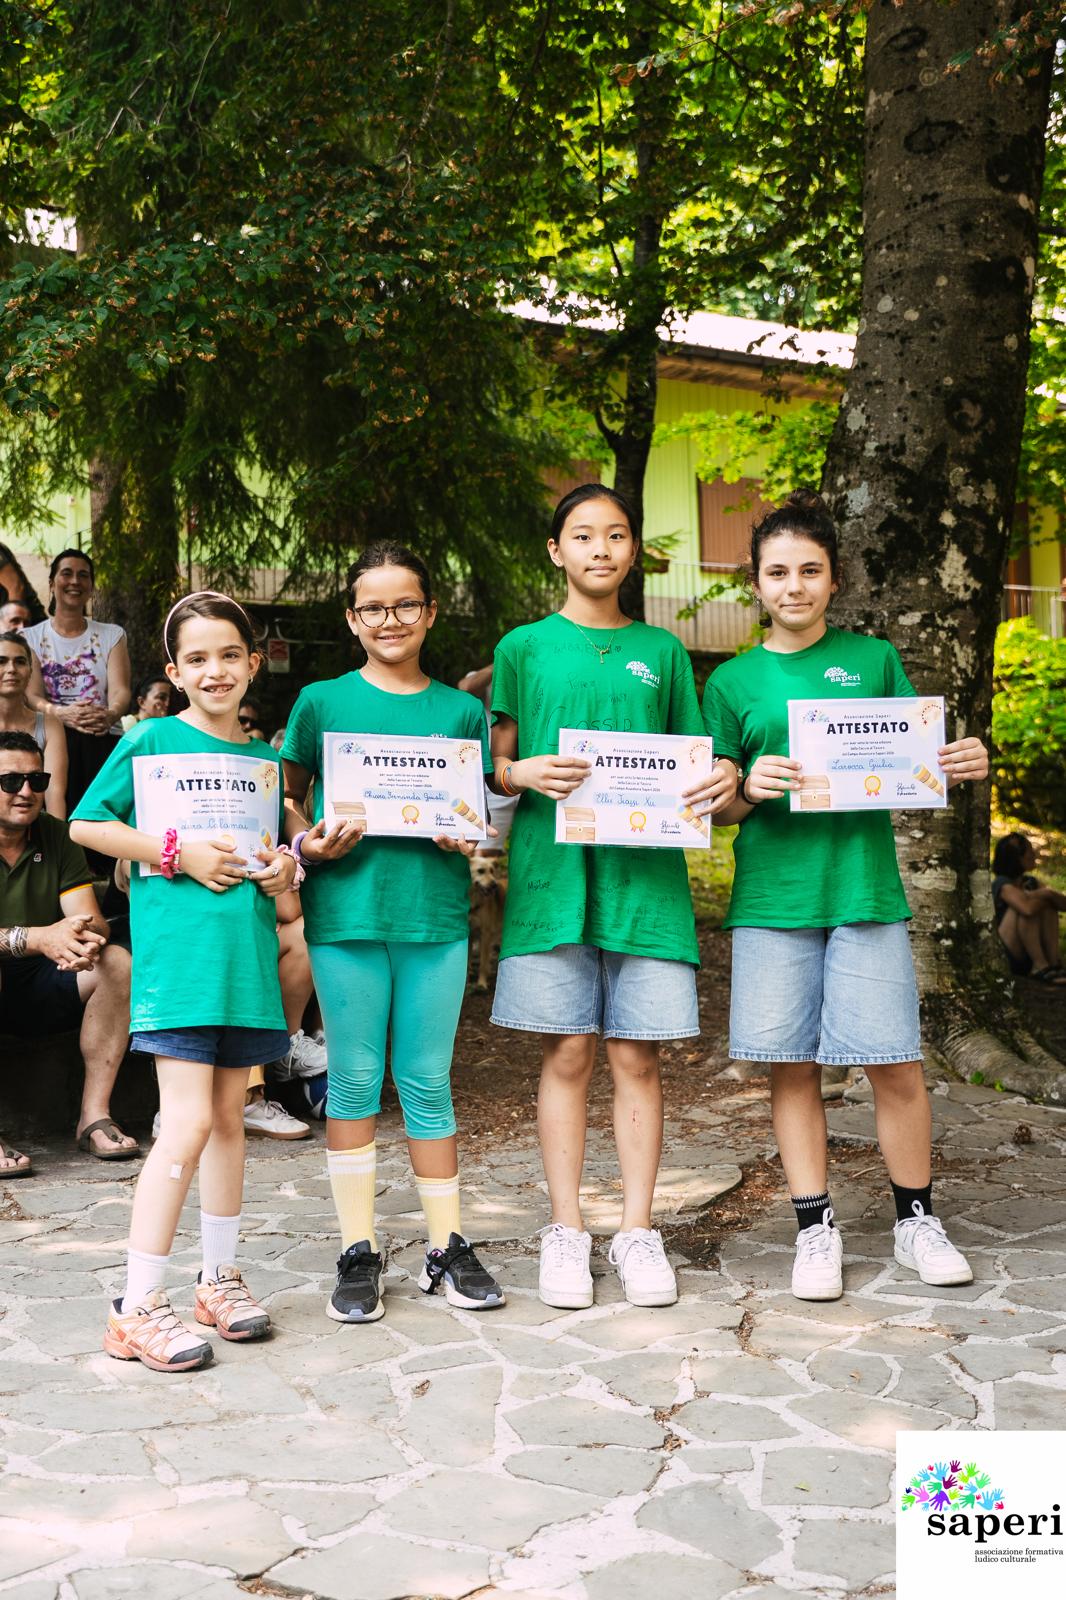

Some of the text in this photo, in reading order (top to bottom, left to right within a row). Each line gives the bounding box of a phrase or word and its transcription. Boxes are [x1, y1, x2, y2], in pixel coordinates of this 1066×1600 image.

[826, 721, 909, 735] ATTESTATO
[362, 756, 447, 768] ATTESTATO
[596, 756, 676, 770] ATTESTATO
